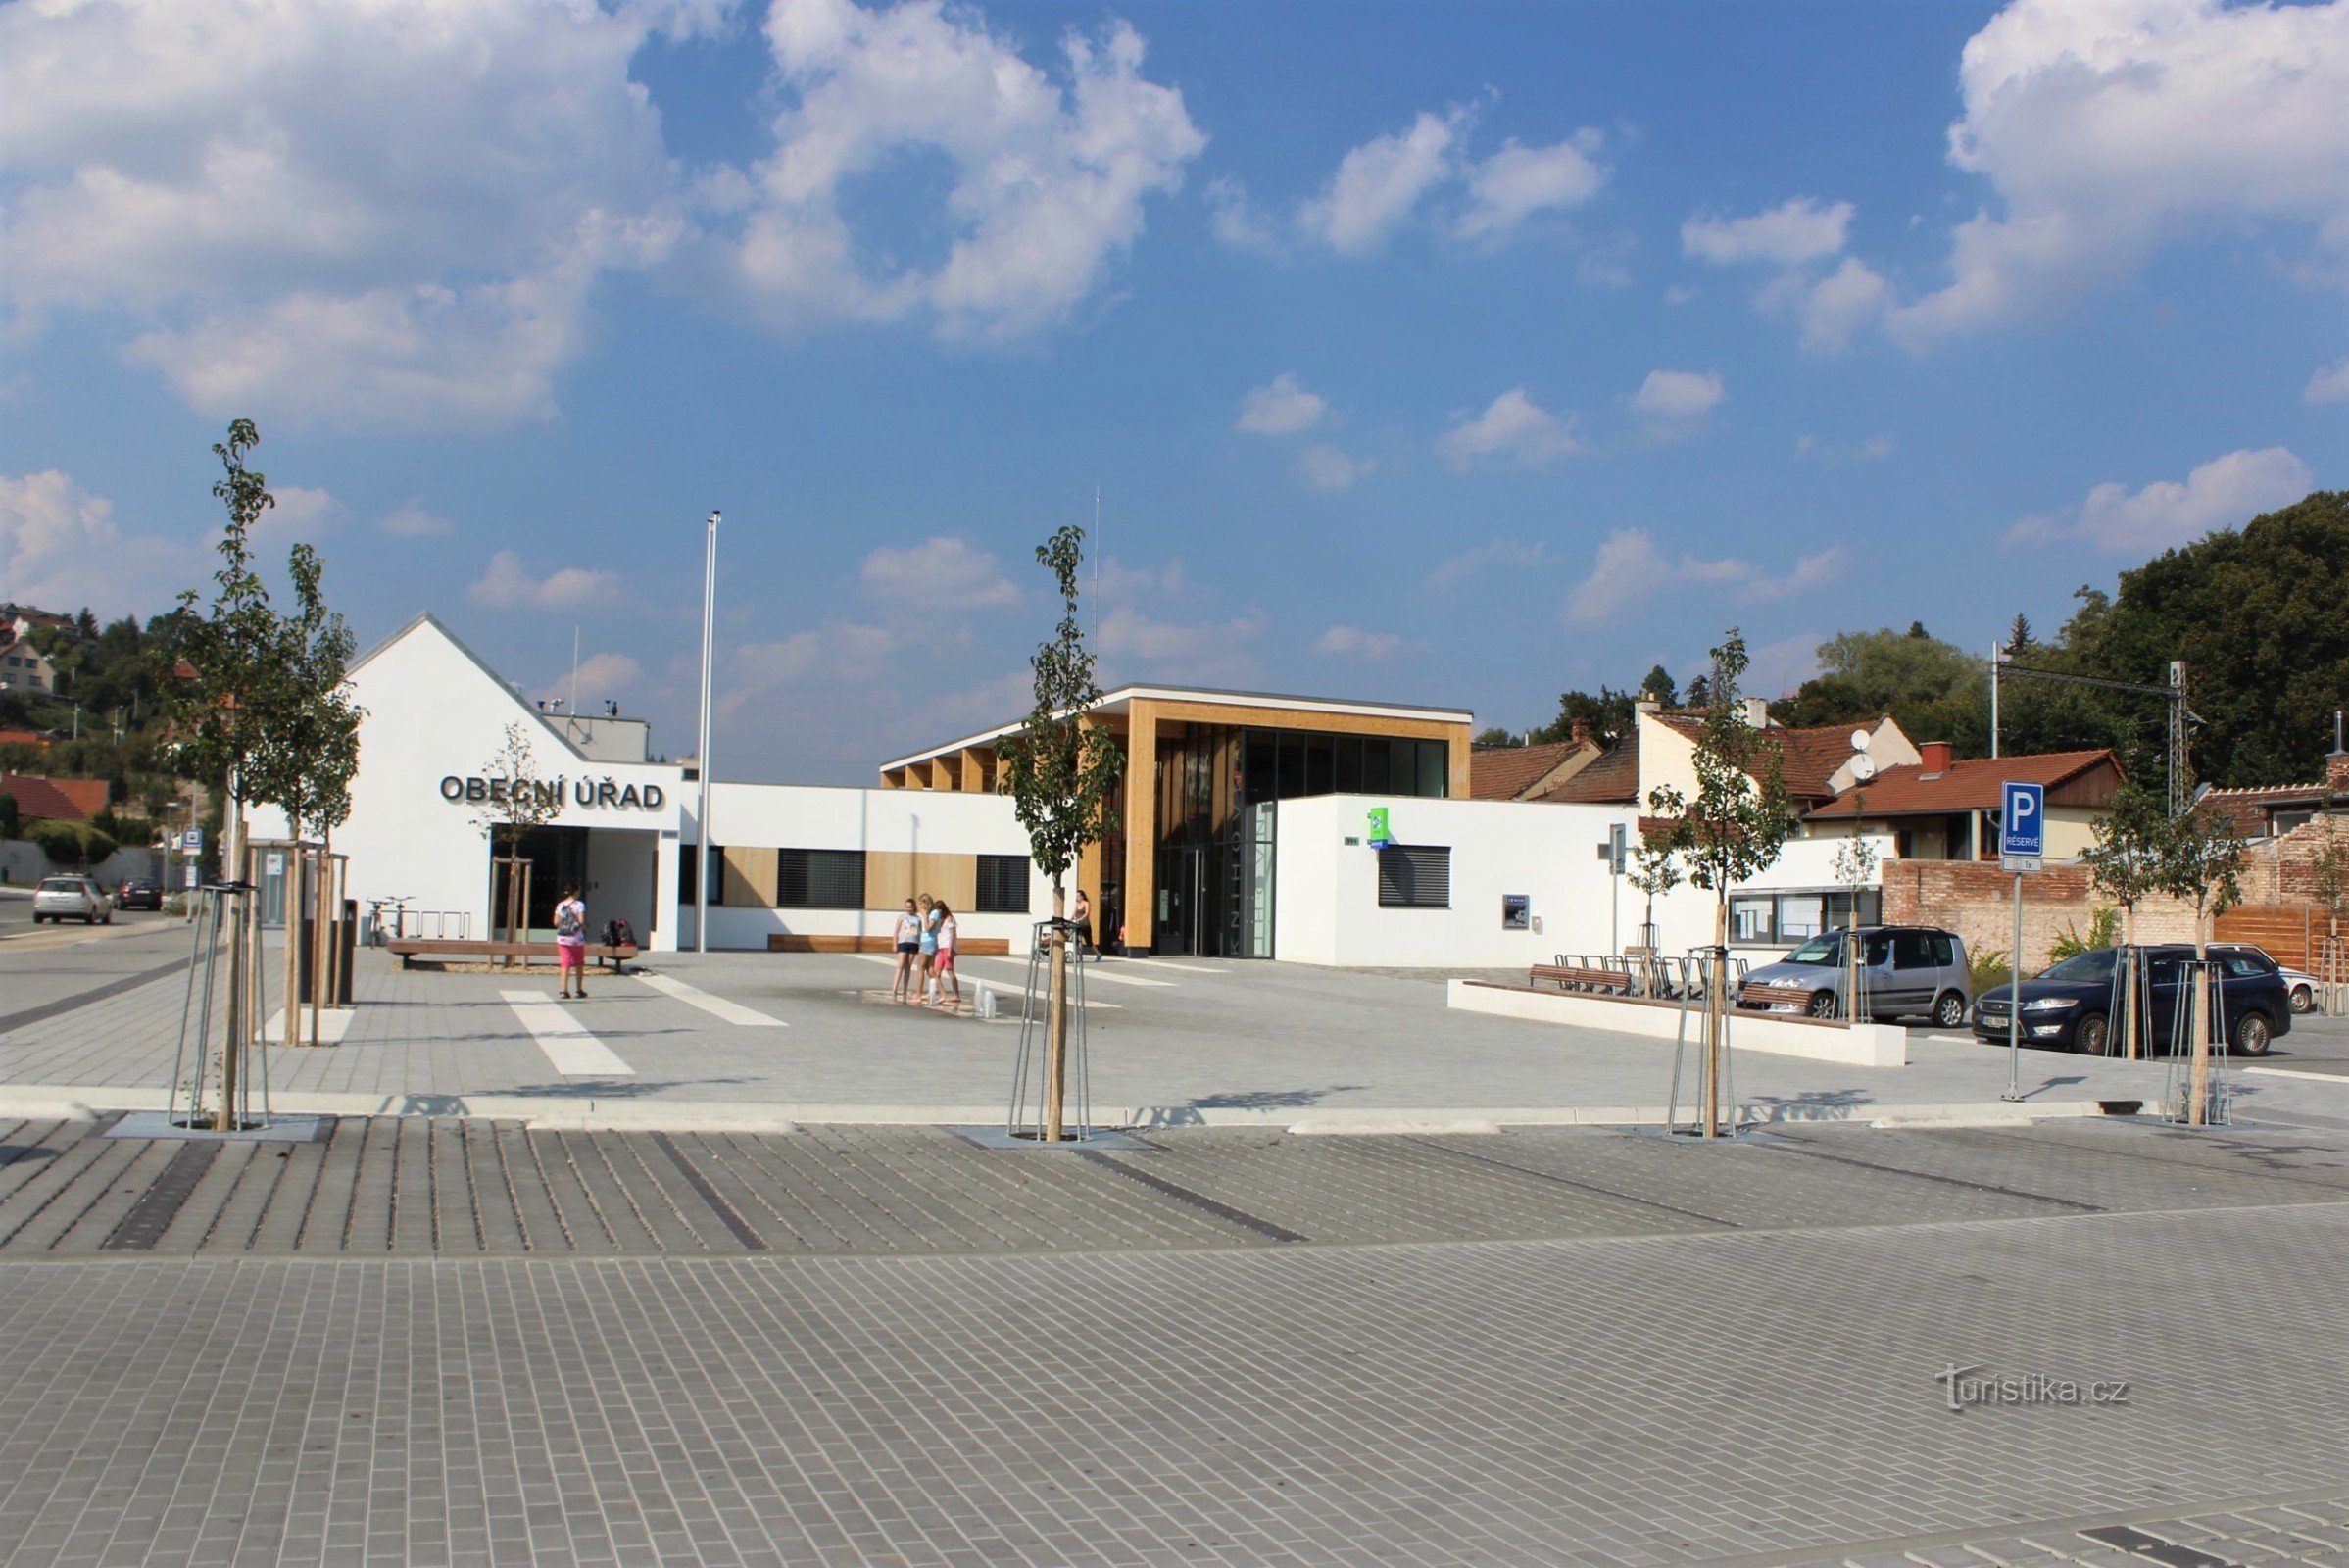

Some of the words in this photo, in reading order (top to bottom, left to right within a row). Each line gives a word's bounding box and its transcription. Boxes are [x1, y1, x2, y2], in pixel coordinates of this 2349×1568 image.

[440, 774, 563, 806] OBECNÍ
[575, 775, 663, 808] ÚŘAD
[2012, 792, 2035, 832] P
